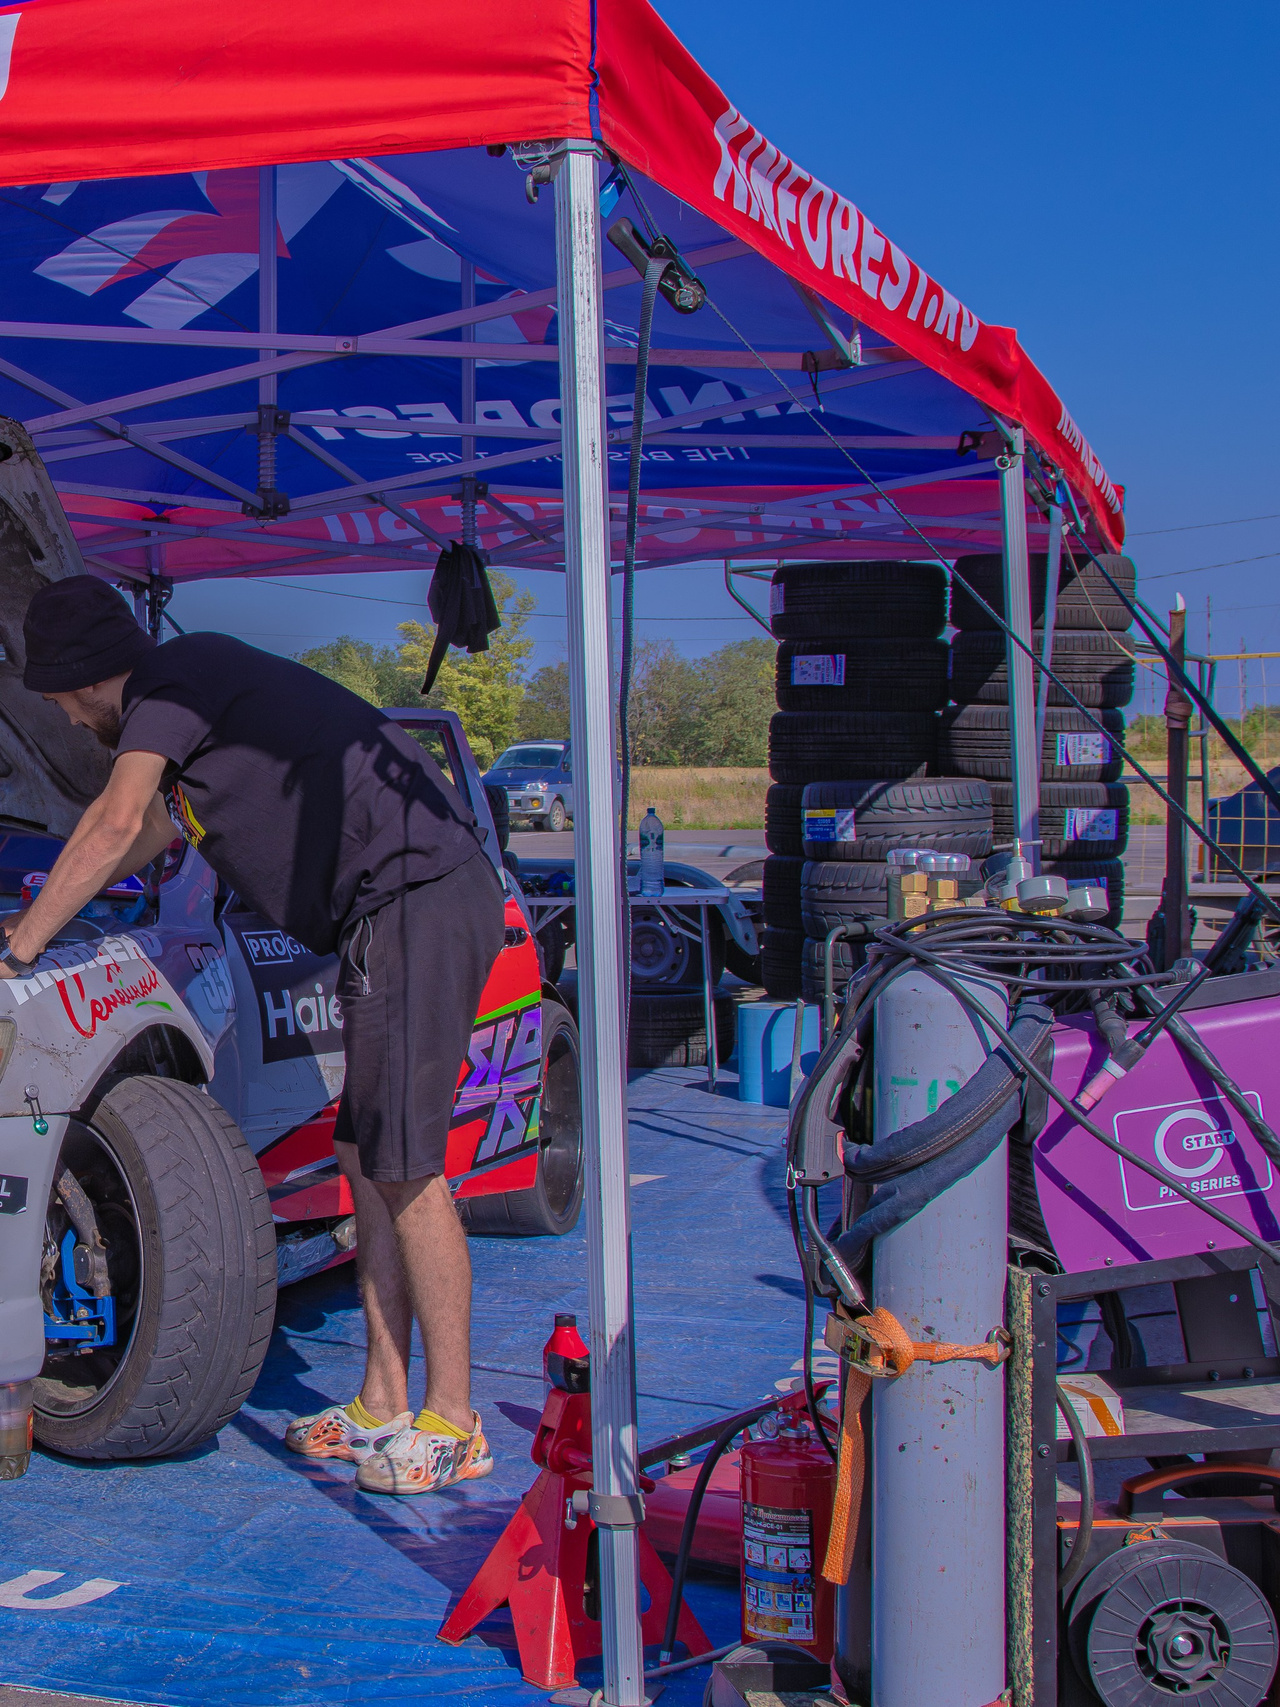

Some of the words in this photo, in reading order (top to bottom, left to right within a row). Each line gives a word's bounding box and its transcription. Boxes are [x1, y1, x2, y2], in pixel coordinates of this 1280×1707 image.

[714, 108, 980, 351] KINFOREST.RU
[264, 983, 344, 1038] Haie
[1185, 1131, 1233, 1149] START
[1191, 1175, 1241, 1193] SERIES
